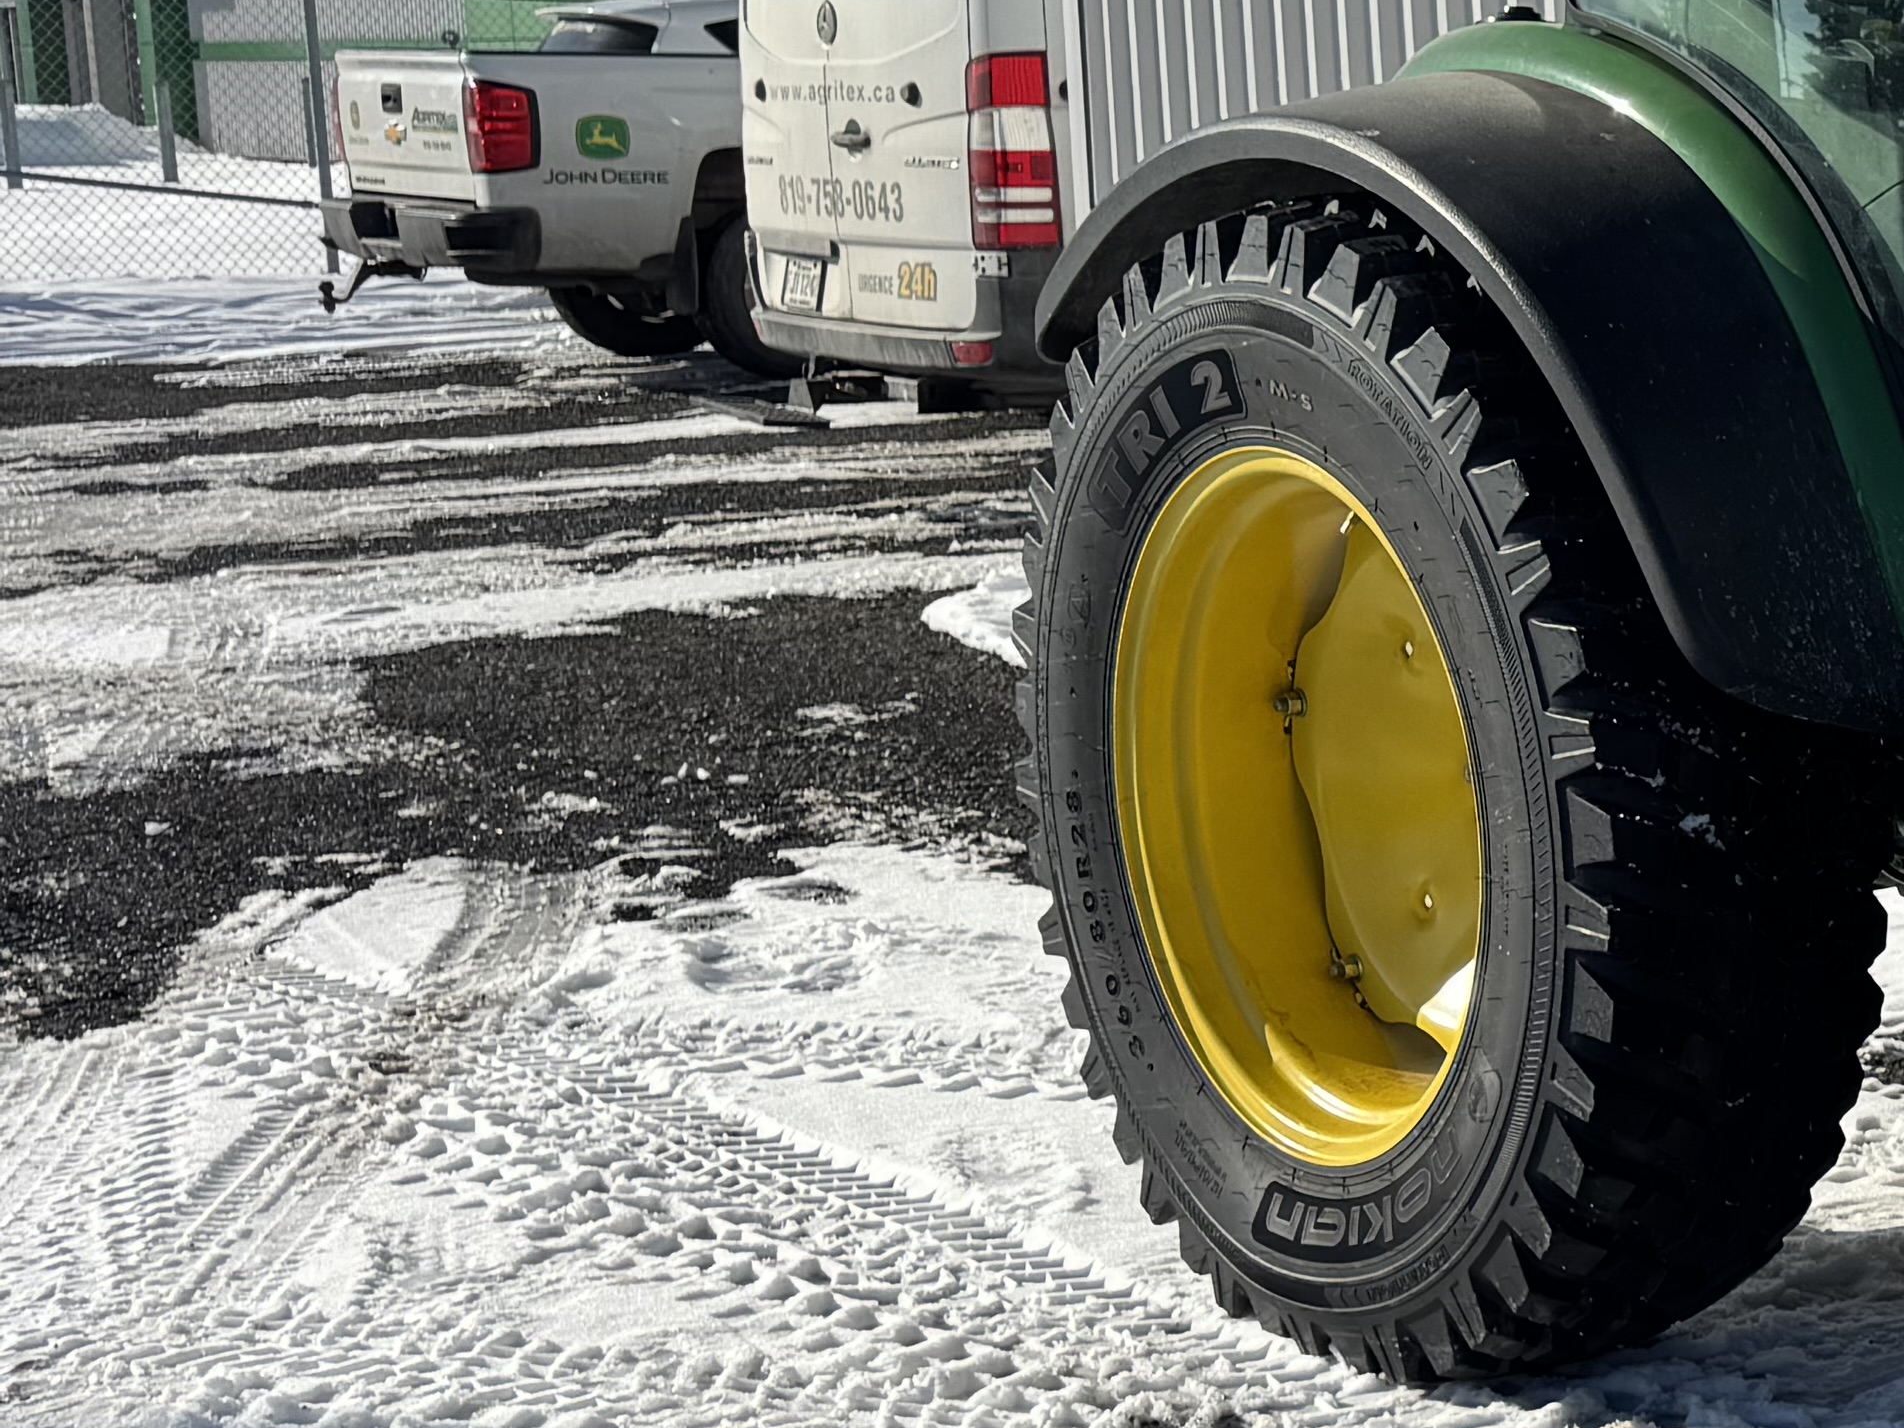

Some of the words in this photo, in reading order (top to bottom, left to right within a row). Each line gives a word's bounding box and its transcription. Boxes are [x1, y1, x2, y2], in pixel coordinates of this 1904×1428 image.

[769, 79, 895, 106] www.agritex.ca
[542, 168, 598, 185] JOHN
[602, 167, 669, 185] DEERE
[858, 273, 894, 296] URGENCE
[897, 260, 938, 302] 24h
[1095, 384, 1181, 509] TRI
[1190, 360, 1233, 415] 2
[1346, 360, 1434, 471] ROTATION
